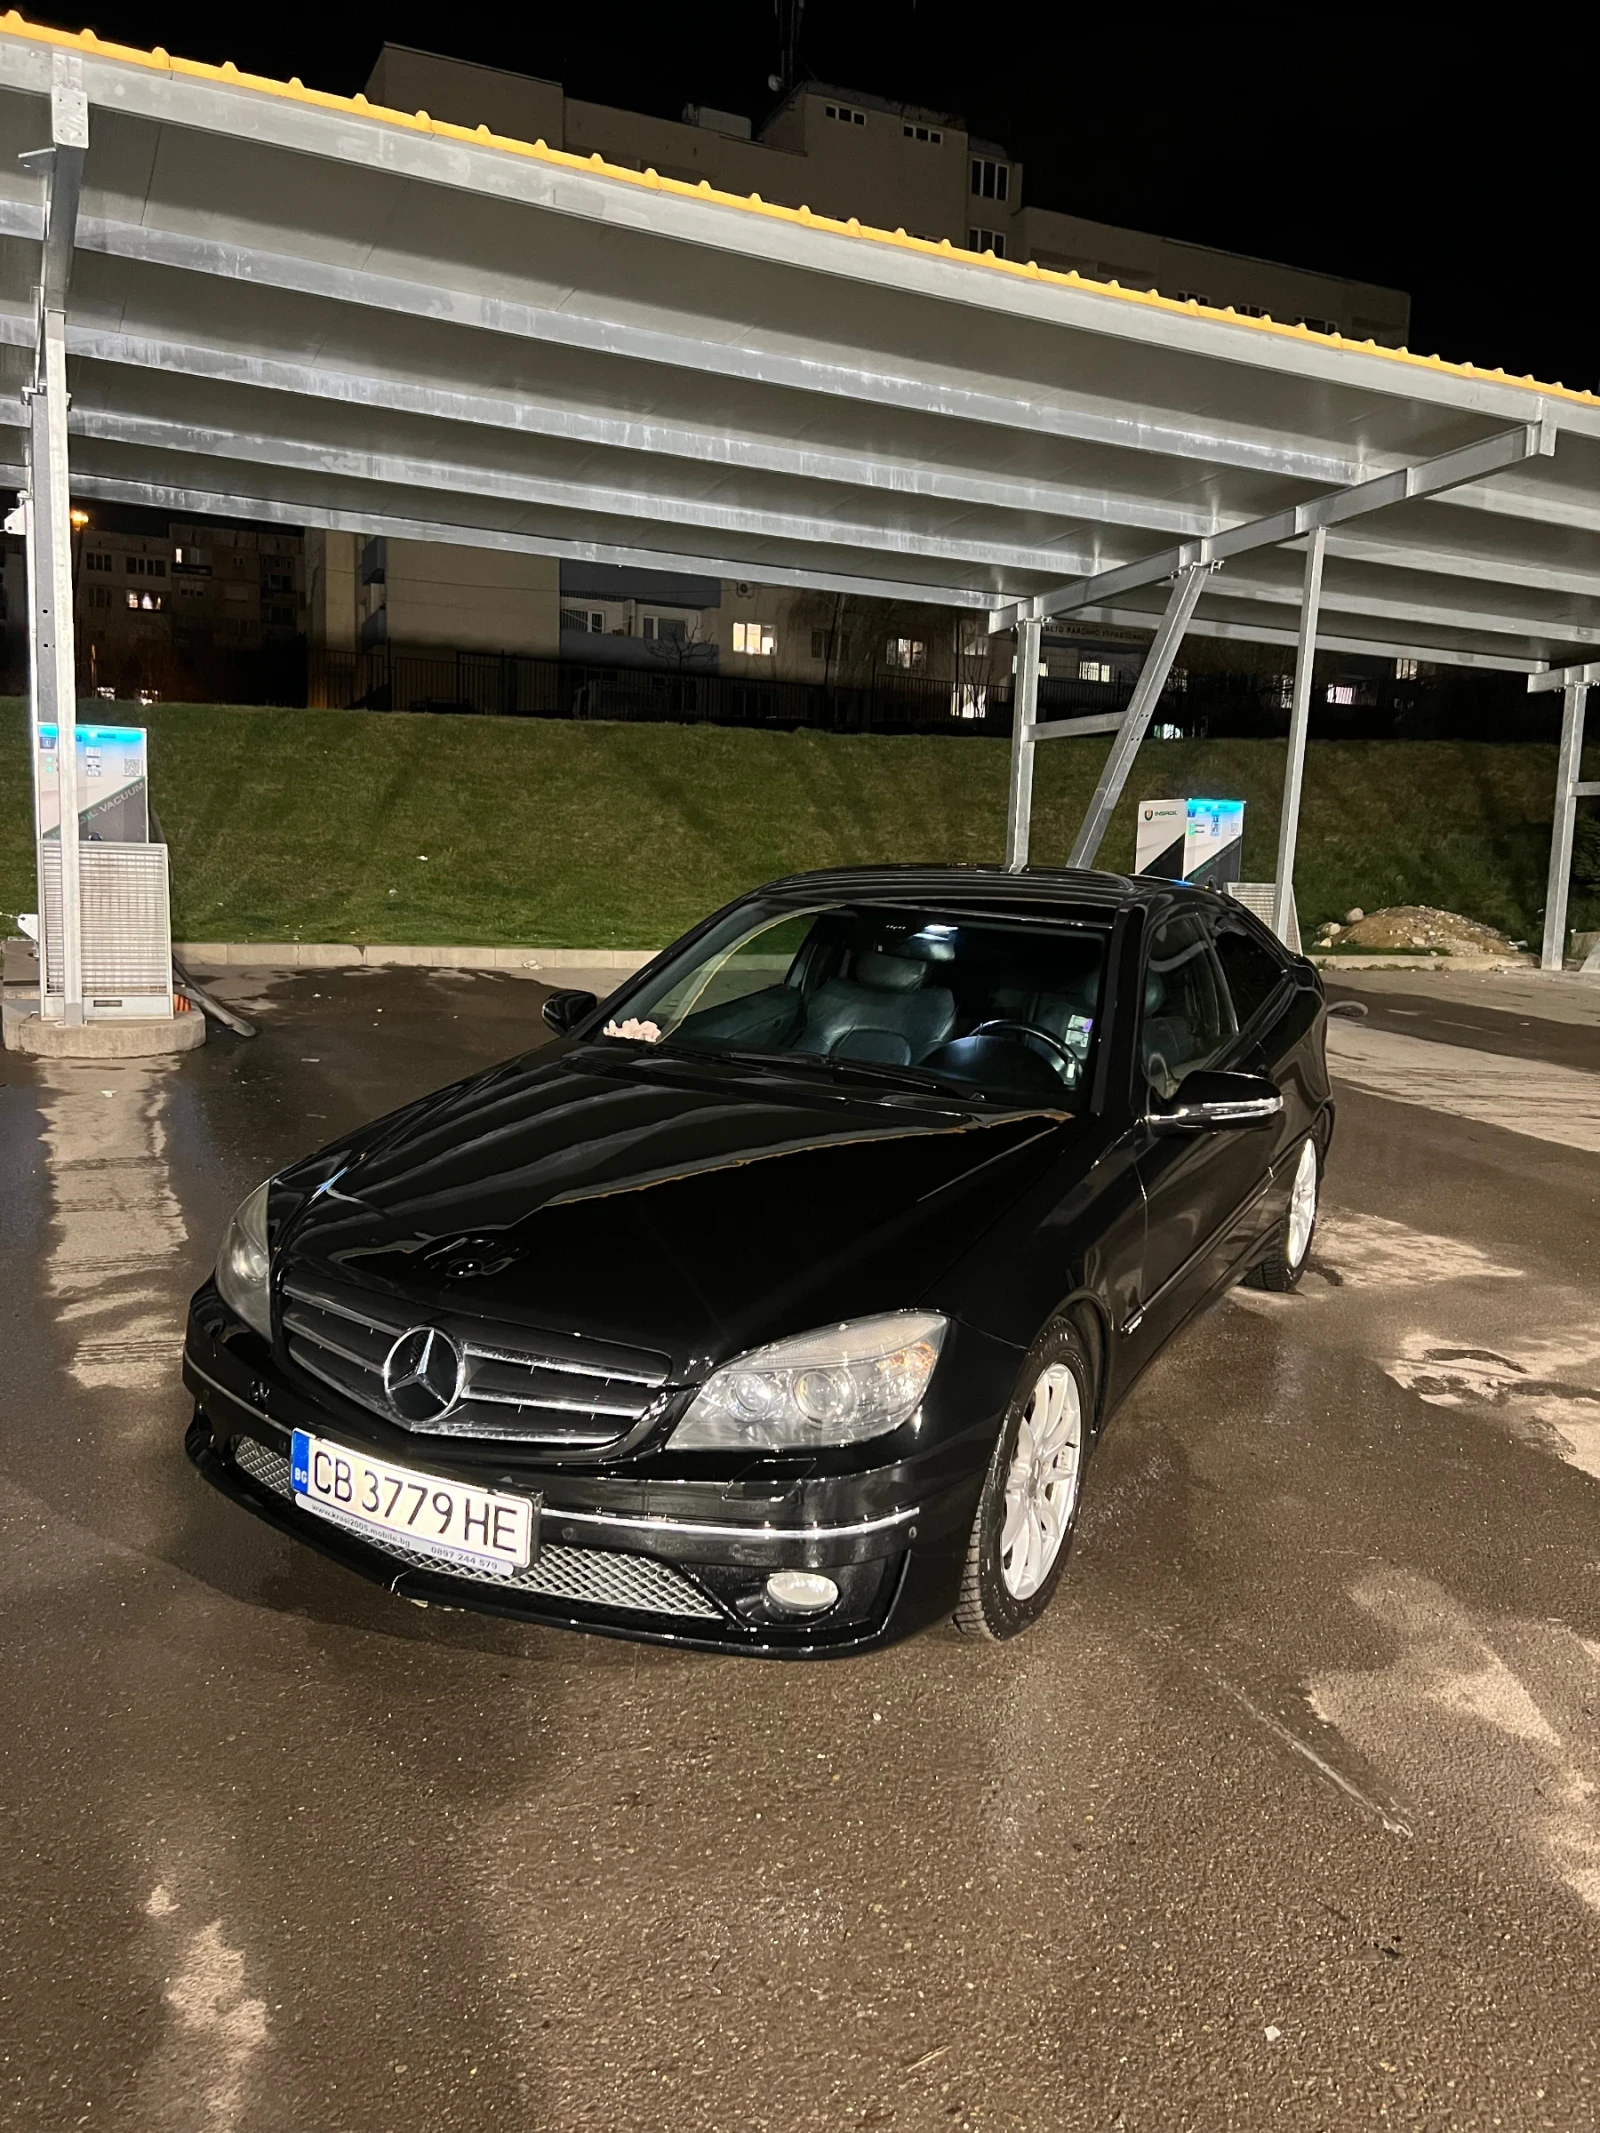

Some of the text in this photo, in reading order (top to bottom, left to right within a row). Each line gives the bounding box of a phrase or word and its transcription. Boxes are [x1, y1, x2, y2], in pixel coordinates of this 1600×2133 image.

[1066, 626, 1100, 636] РАЙОННО
[99, 782, 145, 813] VACUUM
[294, 1467, 308, 1484] BG
[313, 1450, 518, 1553] CB 3779 HE
[311, 1504, 498, 1570] www.krasi2005.mobile.bg 0897 244 579
